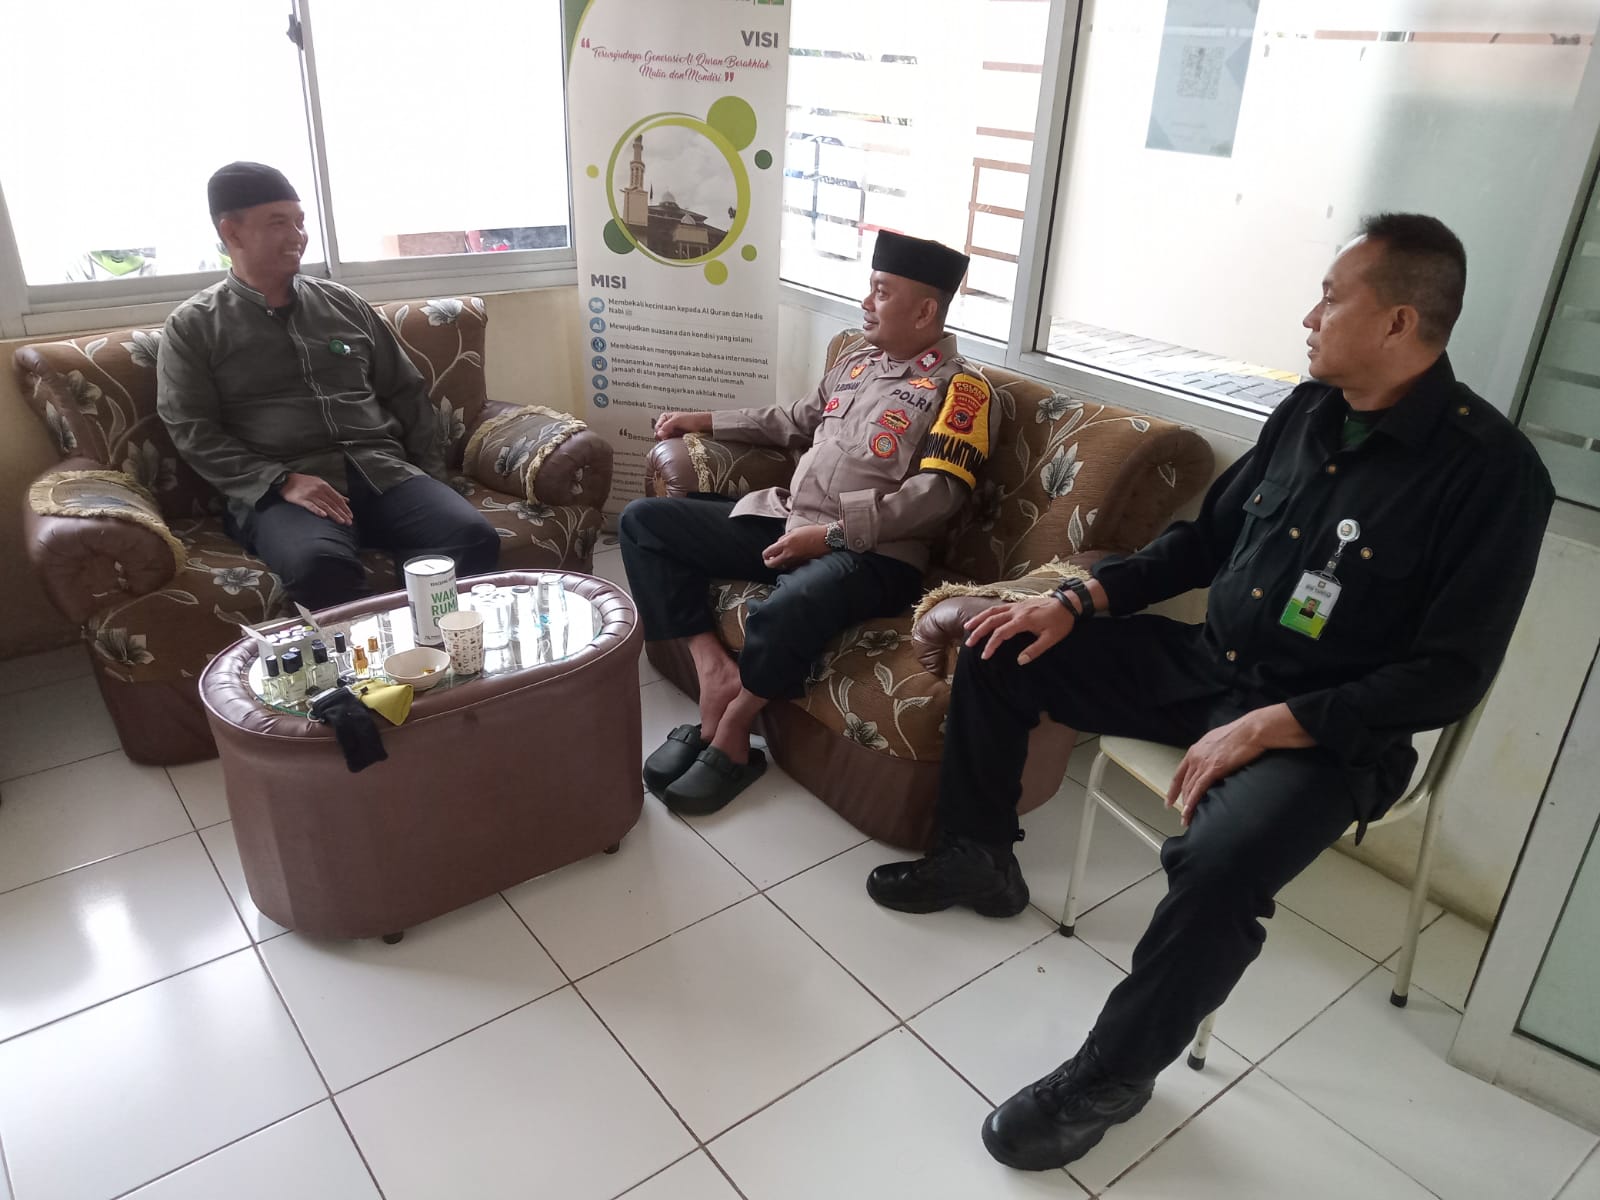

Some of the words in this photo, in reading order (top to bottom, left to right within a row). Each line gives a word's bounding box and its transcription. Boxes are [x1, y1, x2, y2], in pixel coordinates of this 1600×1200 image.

[741, 30, 779, 48] VISI
[724, 55, 769, 69] Berakhlak
[639, 64, 666, 80] Mulia
[669, 70, 684, 80] dan
[591, 273, 627, 290] MISI
[608, 298, 645, 308] Membekali
[645, 302, 677, 312] kecintaan
[677, 305, 701, 314] kepada
[710, 308, 730, 317] Quran
[731, 310, 743, 318] dan
[744, 311, 763, 321] Hadis
[608, 307, 625, 315] Nabi
[609, 322, 650, 333] Mewujudkan
[651, 327, 678, 336] suasana
[679, 329, 691, 337] dan
[692, 330, 716, 340] kondisi
[716, 334, 732, 343] yang
[610, 341, 654, 353] Membiasakan
[655, 348, 701, 358] menggunakan
[701, 351, 725, 361] bahasa
[725, 354, 769, 365] internasional
[611, 357, 654, 367] Menanamkan
[655, 362, 678, 371] manhaj
[692, 366, 713, 374] akidah
[714, 368, 732, 376] ahlus
[732, 370, 757, 379] sunnah
[657, 371, 697, 381] pemahaman
[697, 375, 720, 383] salaful
[720, 378, 745, 386] ummah
[611, 380, 640, 389] Mendidik
[641, 382, 653, 390] dan
[653, 385, 695, 395] mengajarkan
[696, 389, 717, 398] akhlak
[717, 391, 736, 400] mulia
[612, 398, 647, 408] Membekali
[647, 401, 666, 411] Siswa
[890, 389, 933, 413] POLRI
